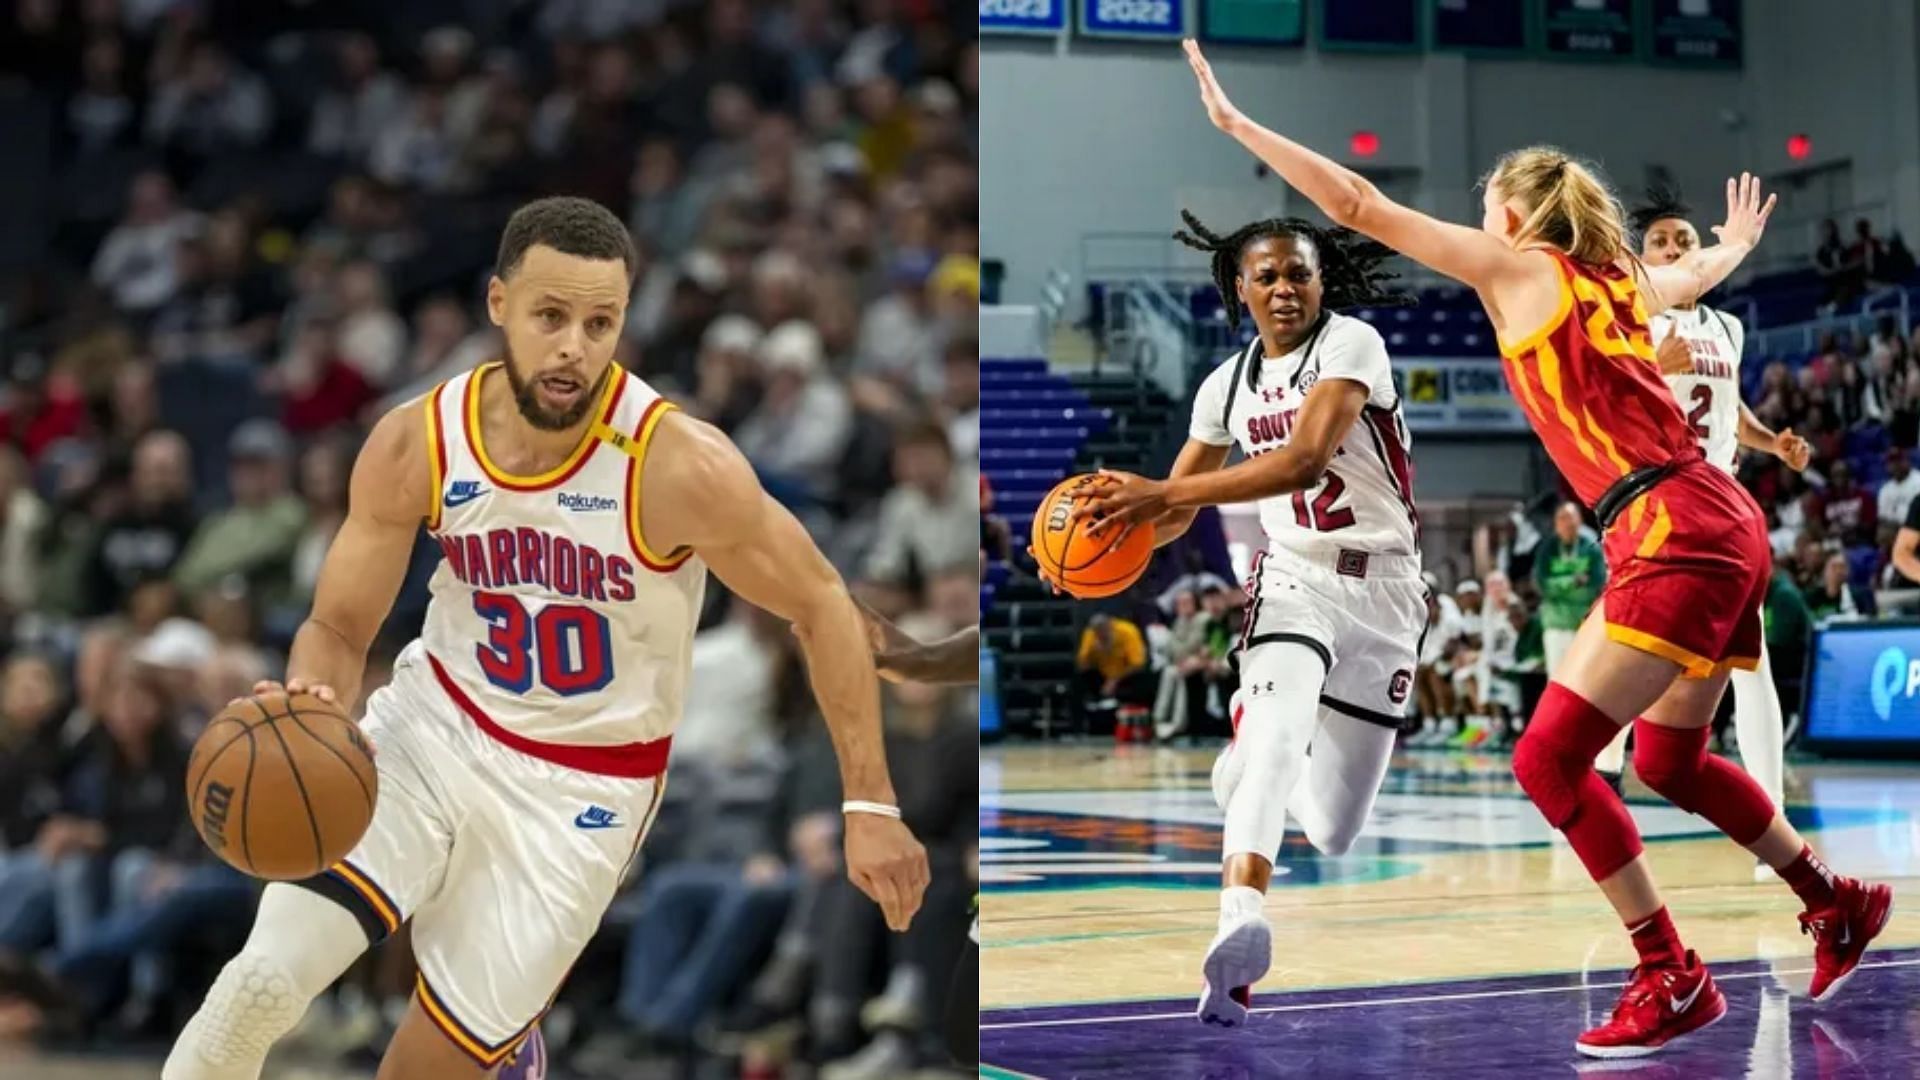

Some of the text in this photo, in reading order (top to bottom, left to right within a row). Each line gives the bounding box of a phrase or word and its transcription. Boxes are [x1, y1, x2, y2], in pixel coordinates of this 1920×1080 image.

[1248, 409, 1299, 445] SOUT
[558, 492, 618, 511] Rakuten
[1291, 470, 1356, 532] 12
[437, 527, 636, 601] WARRIORS
[473, 590, 615, 697] 30
